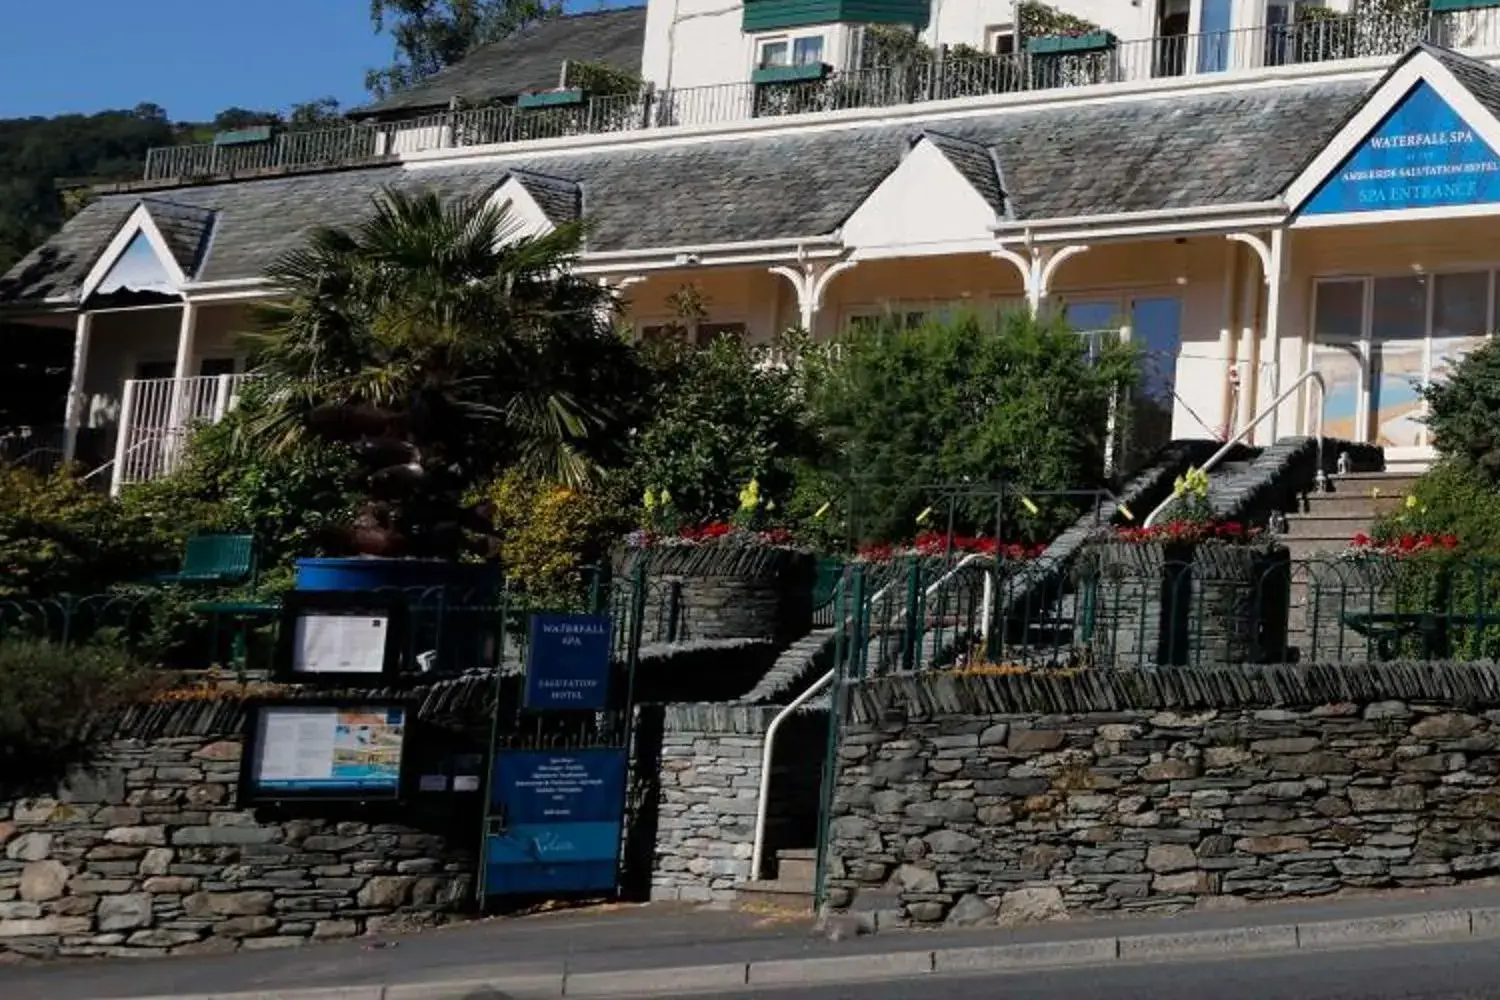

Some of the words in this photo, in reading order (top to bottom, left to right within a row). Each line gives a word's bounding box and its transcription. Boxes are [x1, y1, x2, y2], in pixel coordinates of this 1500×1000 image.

[1370, 132, 1447, 150] WATERFALL
[1449, 130, 1474, 144] SPA
[1358, 187, 1386, 203] SPA
[1389, 181, 1477, 201] ENTRANCE
